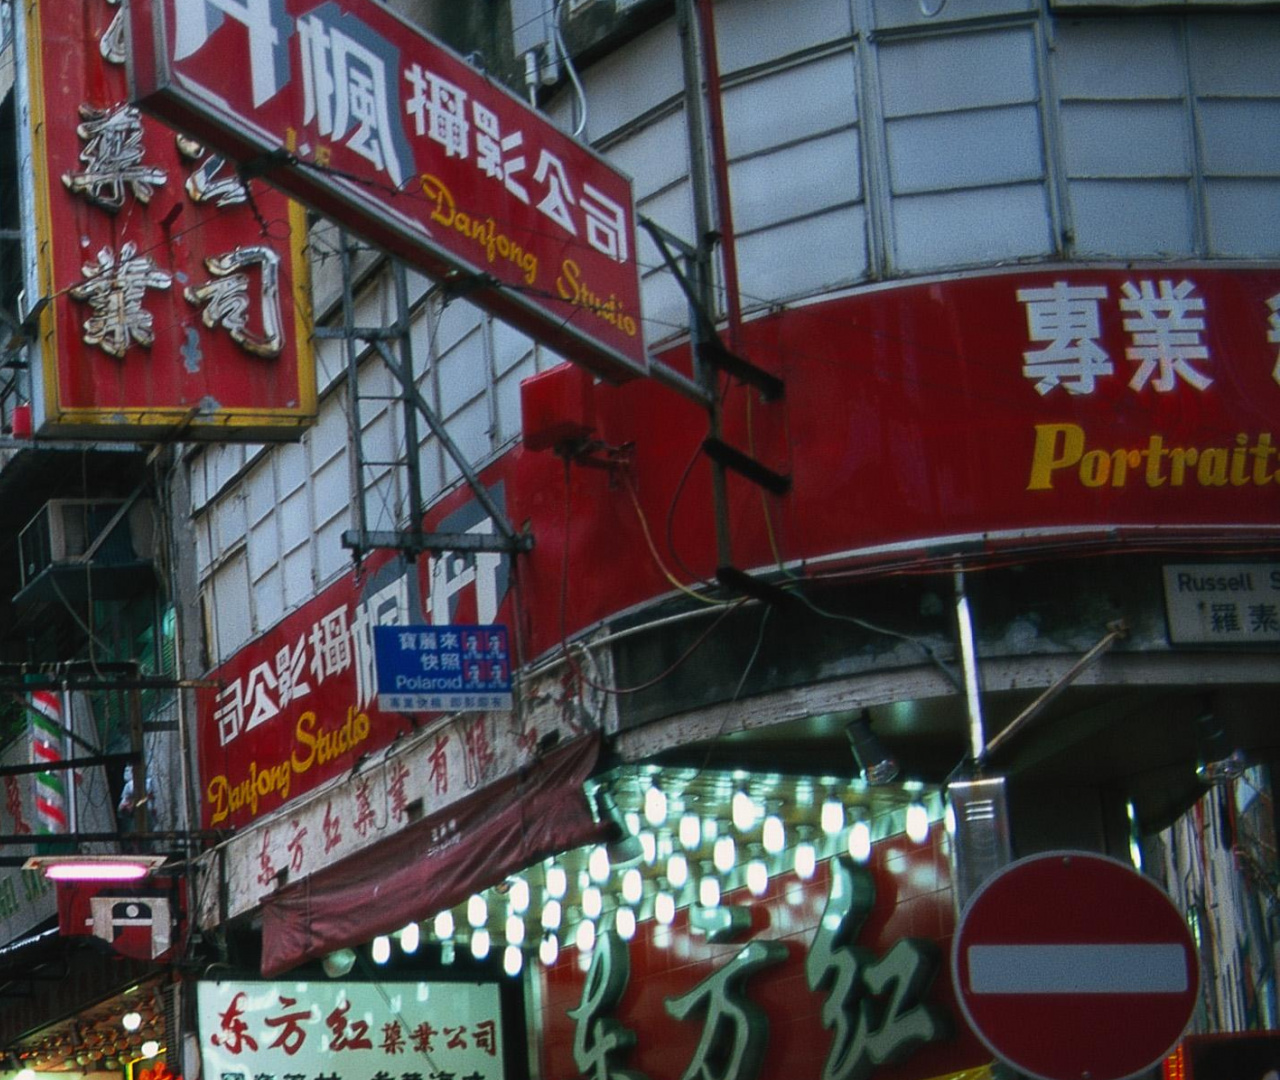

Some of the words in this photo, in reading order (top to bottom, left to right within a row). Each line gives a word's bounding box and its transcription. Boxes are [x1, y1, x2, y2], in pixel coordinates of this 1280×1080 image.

[419, 173, 538, 284] Danfong
[556, 259, 638, 337] Studio
[1016, 279, 1214, 397] 專業
[1025, 422, 1280, 492] Portrait
[1177, 572, 1255, 592] Russell
[396, 675, 463, 690] Polaroid
[208, 761, 291, 827] Danfong
[290, 710, 371, 774] Studio
